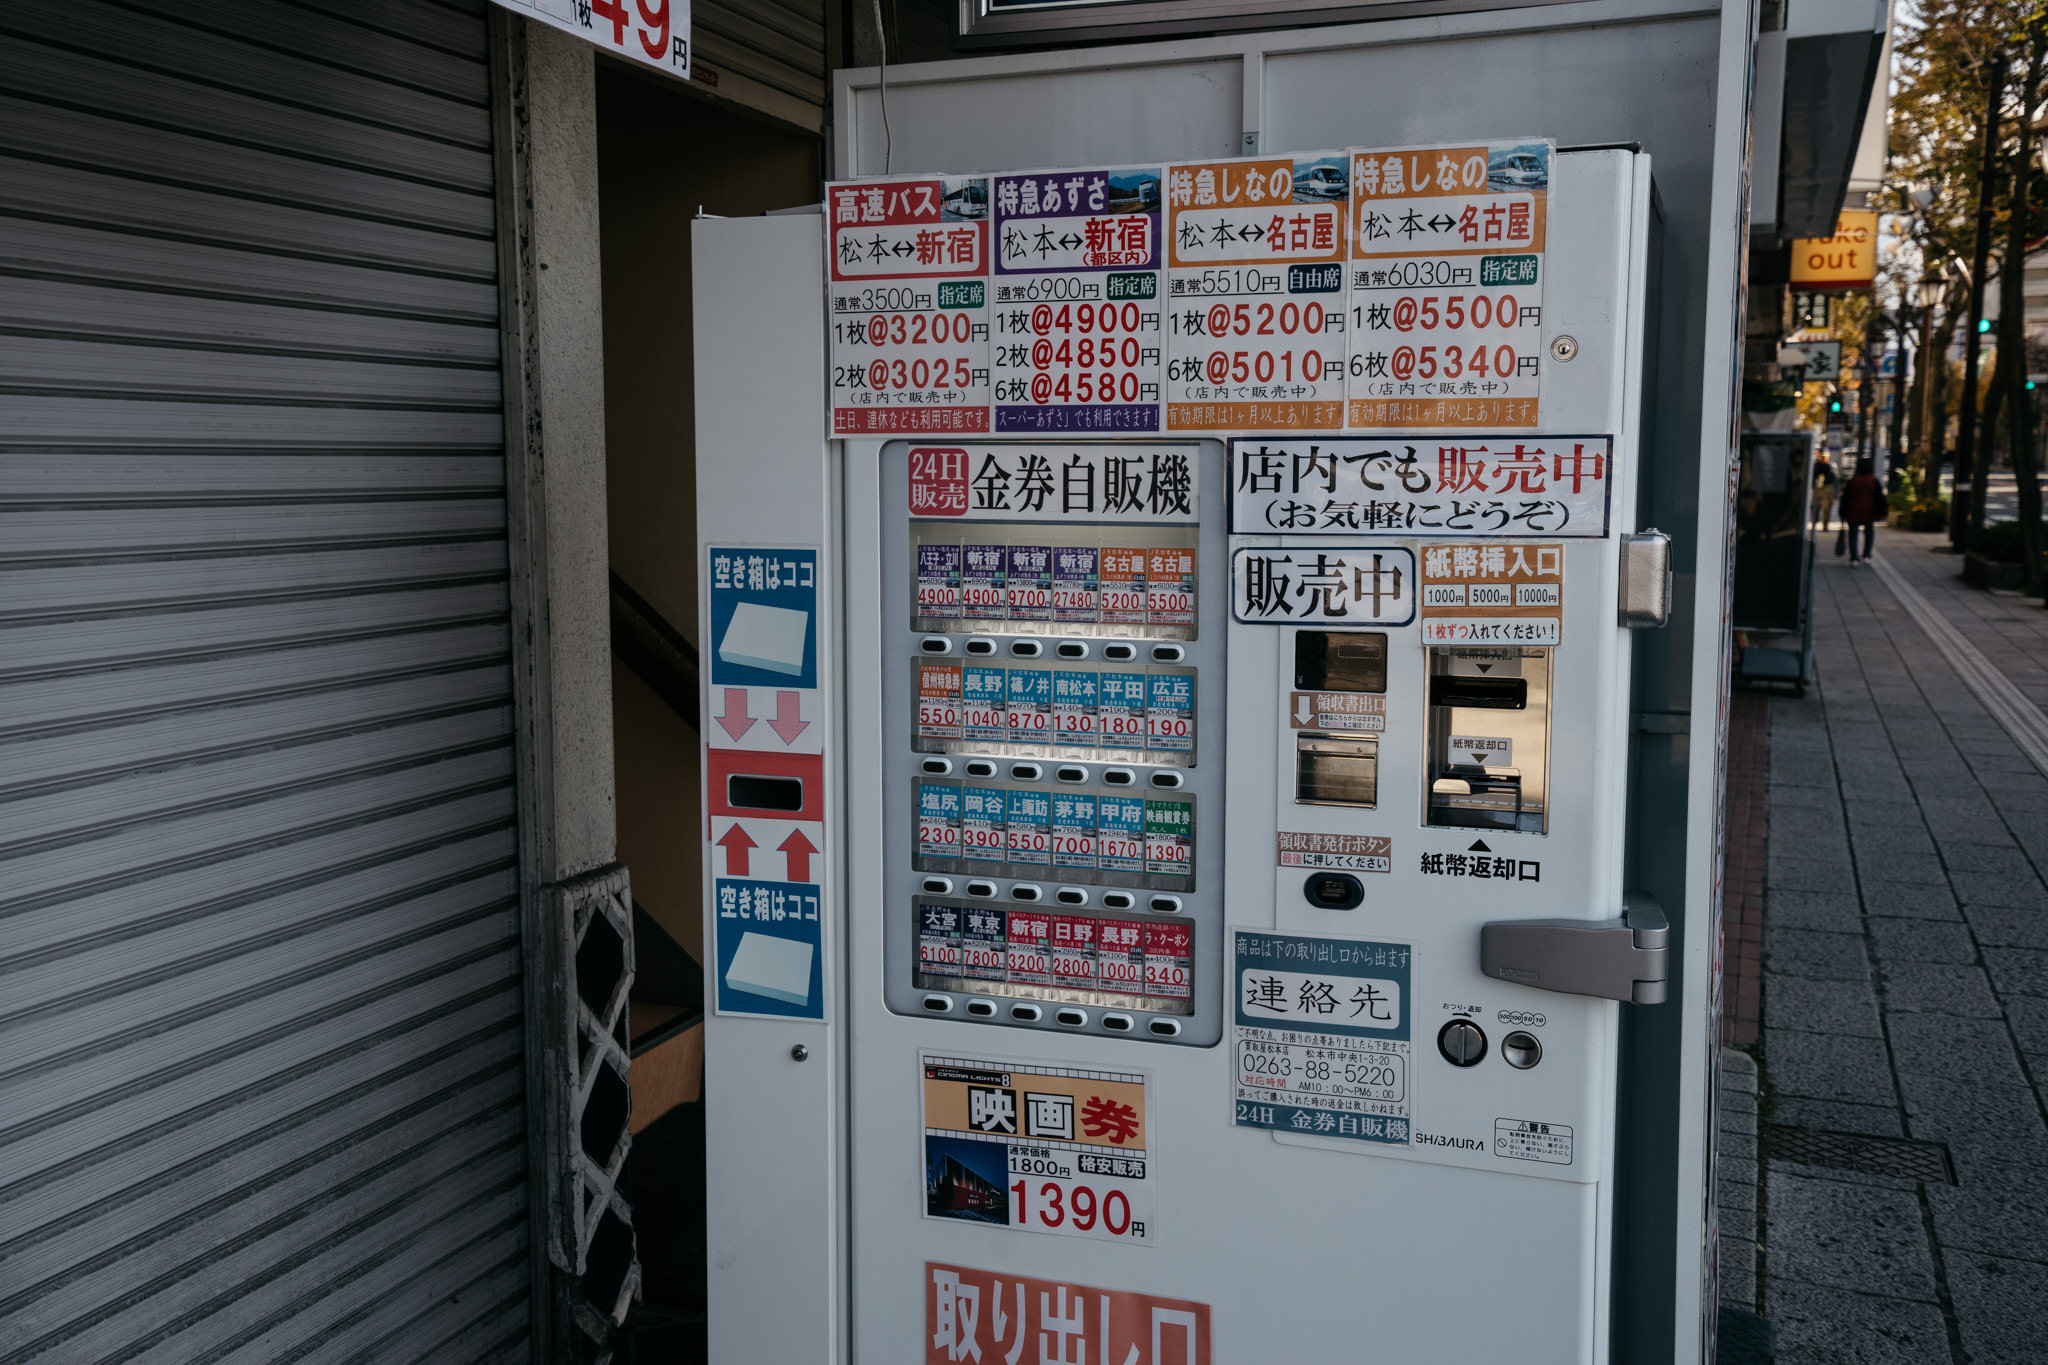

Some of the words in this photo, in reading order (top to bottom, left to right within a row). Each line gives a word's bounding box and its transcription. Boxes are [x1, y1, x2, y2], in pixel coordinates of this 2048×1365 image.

[1170, 167, 1292, 207] 特急しなの
[1355, 154, 1487, 196] 特急しなの
[835, 186, 937, 224] 高速バス
[998, 175, 1106, 217] 特急あずさ
[1178, 218, 1236, 250] 松本
[1265, 211, 1334, 253] 名古屋
[1362, 207, 1427, 241] 松本
[1457, 200, 1531, 243] 名古屋
[840, 233, 891, 266] 松本
[915, 227, 976, 266] 新宿
[1002, 223, 1058, 262] 松本
[1084, 216, 1148, 253] 新宿
[1353, 260, 1473, 288] 通常6030円
[1482, 257, 1536, 283] 指定席
[1808, 249, 1858, 270] out
[997, 277, 1099, 302] 通常6900円
[1108, 275, 1155, 297] 指定席
[1169, 269, 1281, 297] 通常5510円
[1287, 266, 1341, 291] 自由席
[834, 287, 932, 312] 通常3500円
[939, 283, 984, 306] 指定席
[1352, 293, 1541, 333] 1枚@5500円
[834, 312, 989, 349] 1枚@3200円
[996, 301, 1160, 337] 1枚@4900円
[1169, 300, 1345, 339] 1枚@5200円
[995, 336, 1160, 371] 2枚@4850円
[1167, 349, 1345, 385] 6枚@5010円
[1349, 343, 1539, 382] 6枚@5340円
[834, 357, 989, 394] 2枚@3025円
[994, 370, 1160, 406] 6枚@4580円
[911, 452, 965, 481] 24H
[1237, 443, 1605, 495] 店内でも販売中
[911, 483, 966, 510] 販売
[970, 453, 1192, 516] 金券自販機
[714, 555, 814, 591] 空き箱はココ
[967, 550, 1000, 567] 新宿
[1012, 551, 1047, 568] 新宿
[1059, 551, 1094, 569] 新宿
[1103, 554, 1145, 573] 名古屋
[1151, 555, 1192, 574] 名古屋
[1424, 546, 1560, 579] 紙幣挿入口
[1243, 553, 1402, 619] 販売中
[1428, 588, 1464, 604] 1000円
[1472, 588, 1509, 605] 5000円
[1517, 588, 1557, 604] 10000円
[964, 674, 1002, 693] 長野
[1055, 678, 1096, 697] 南松本
[1102, 680, 1143, 699] 平田
[1152, 681, 1190, 698] 広丘
[1316, 693, 1387, 713] 領収書出口
[1452, 738, 1508, 752] 紙幣返却口
[965, 795, 1003, 815] 岡谷
[1055, 800, 1094, 820] 茅野
[1100, 803, 1142, 824] 甲府
[1278, 833, 1392, 855] 領収書発行ボタン
[1282, 853, 1387, 871] 最後に押してください
[1420, 852, 1541, 883] 紙幣返却口
[720, 885, 818, 922] 空き箱はココ
[925, 910, 957, 927] 大宮
[968, 914, 1001, 930] 東京
[1011, 918, 1048, 940] 新宿
[1055, 922, 1093, 942] 日野
[1101, 926, 1140, 946] 長野
[1236, 935, 1410, 970] 商品は下の取り出し口から出ます
[1245, 974, 1393, 1022] 連絡先
[1001, 1073, 1010, 1088] 8
[1243, 1054, 1395, 1088] 0263-88-5220
[970, 1088, 1140, 1145] 映画券
[1236, 1104, 1275, 1125] 24H
[1290, 1108, 1410, 1142] 金券自販機
[1009, 1145, 1051, 1160] 通常価格
[1010, 1157, 1071, 1177] 1800円
[1080, 1155, 1145, 1178] 格安販売
[1010, 1179, 1146, 1238] 1390円
[933, 1268, 1197, 1365] 取り出し口
